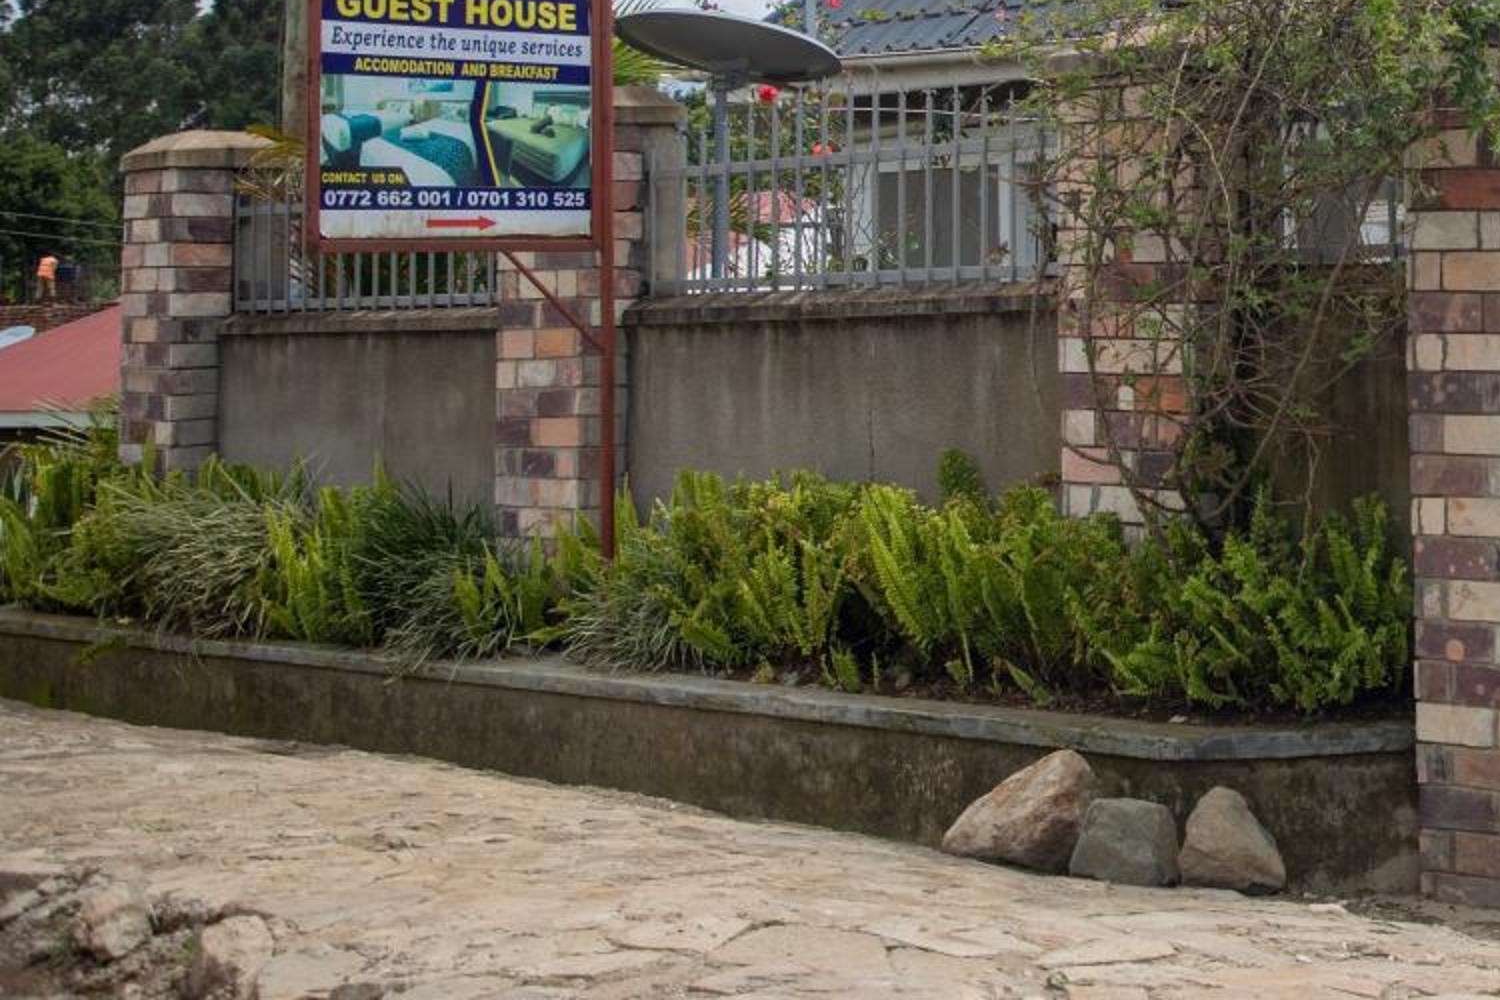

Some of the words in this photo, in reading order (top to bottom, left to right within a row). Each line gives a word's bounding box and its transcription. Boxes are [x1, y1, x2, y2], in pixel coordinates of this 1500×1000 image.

[331, 25, 425, 51] Experience
[429, 32, 456, 50] the
[461, 36, 516, 58] unique
[521, 40, 583, 58] services
[354, 56, 455, 77] ACCOMODATION
[461, 62, 487, 77] AND
[490, 64, 559, 81] BREAKFAST
[321, 172, 367, 184] CONTACT
[324, 190, 372, 207] 0772
[377, 190, 413, 207] 662
[417, 190, 451, 207] 001
[457, 191, 463, 207] /
[467, 191, 509, 207] 0701
[515, 191, 549, 207] 310
[553, 191, 586, 208] 525
